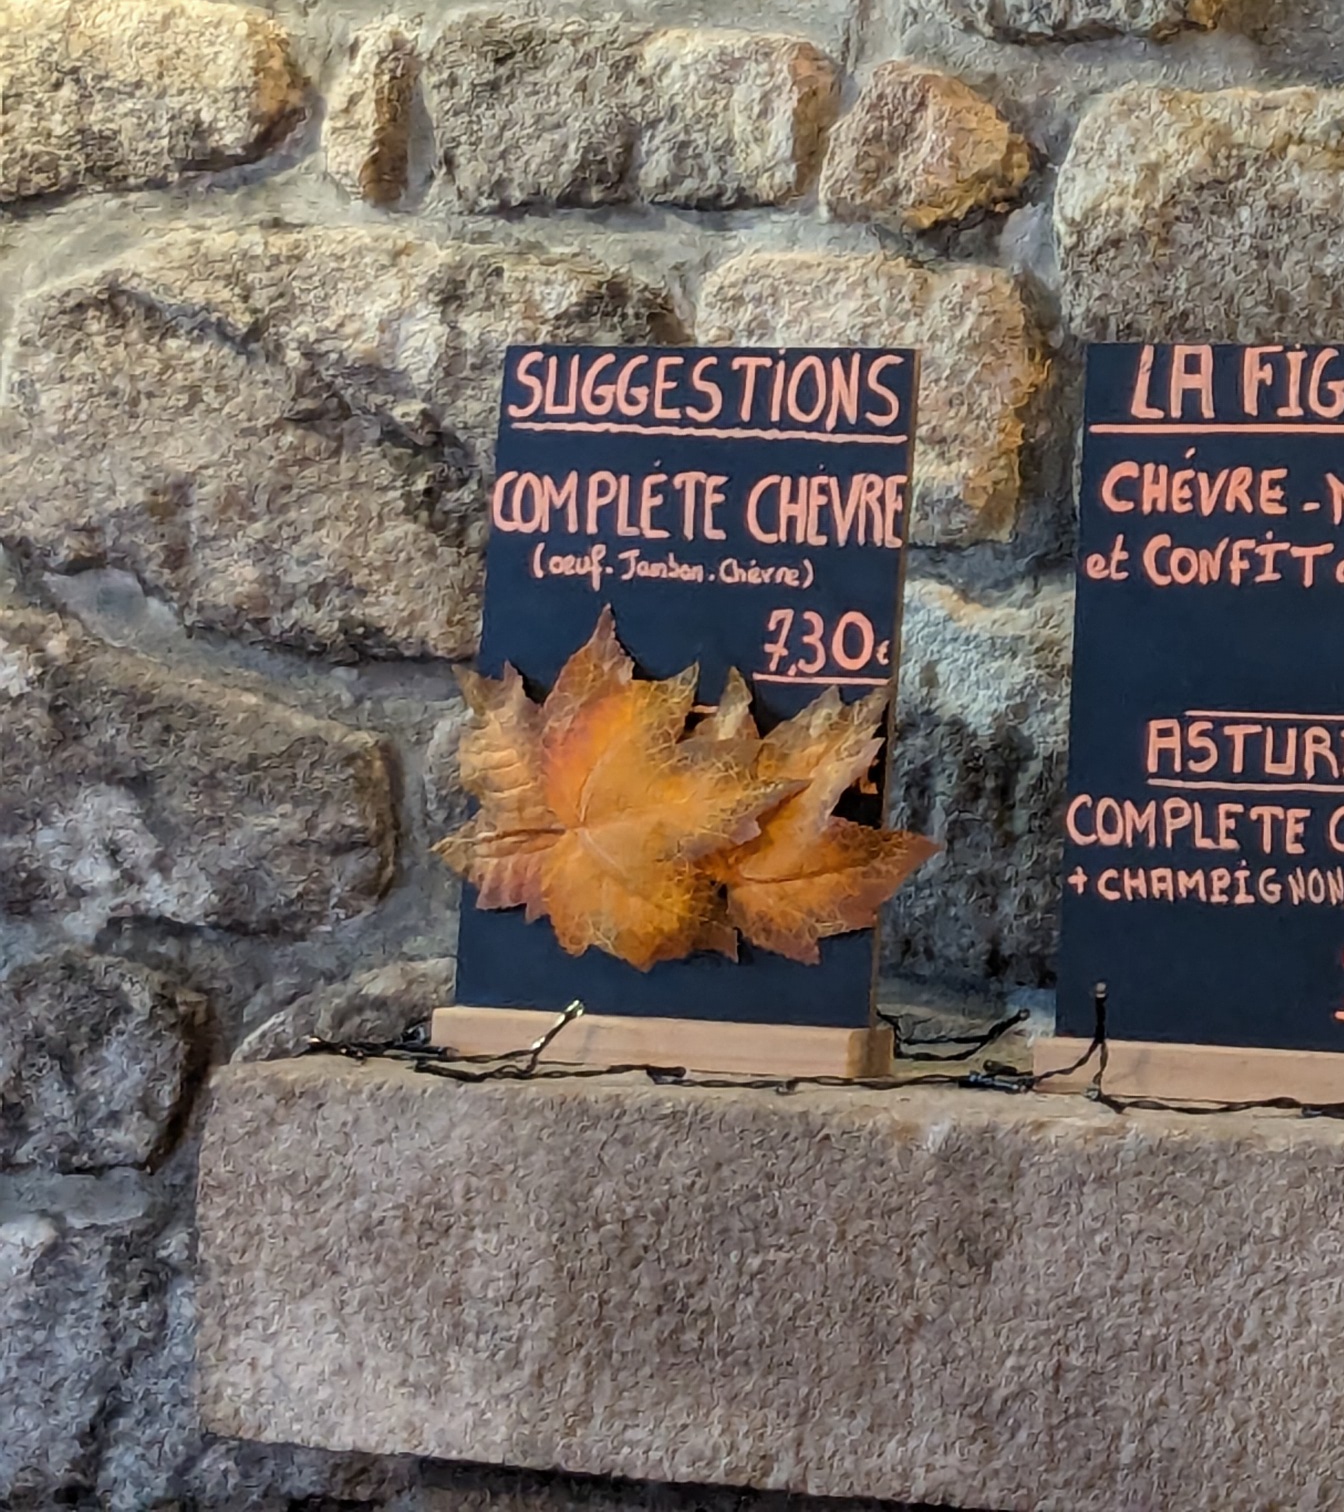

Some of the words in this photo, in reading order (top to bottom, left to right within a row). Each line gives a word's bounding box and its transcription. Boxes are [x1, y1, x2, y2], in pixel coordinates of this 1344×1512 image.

[1130, 343, 1216, 420] LA
[1085, 533, 1131, 582] et
[1064, 794, 1312, 855] COMPLETE
